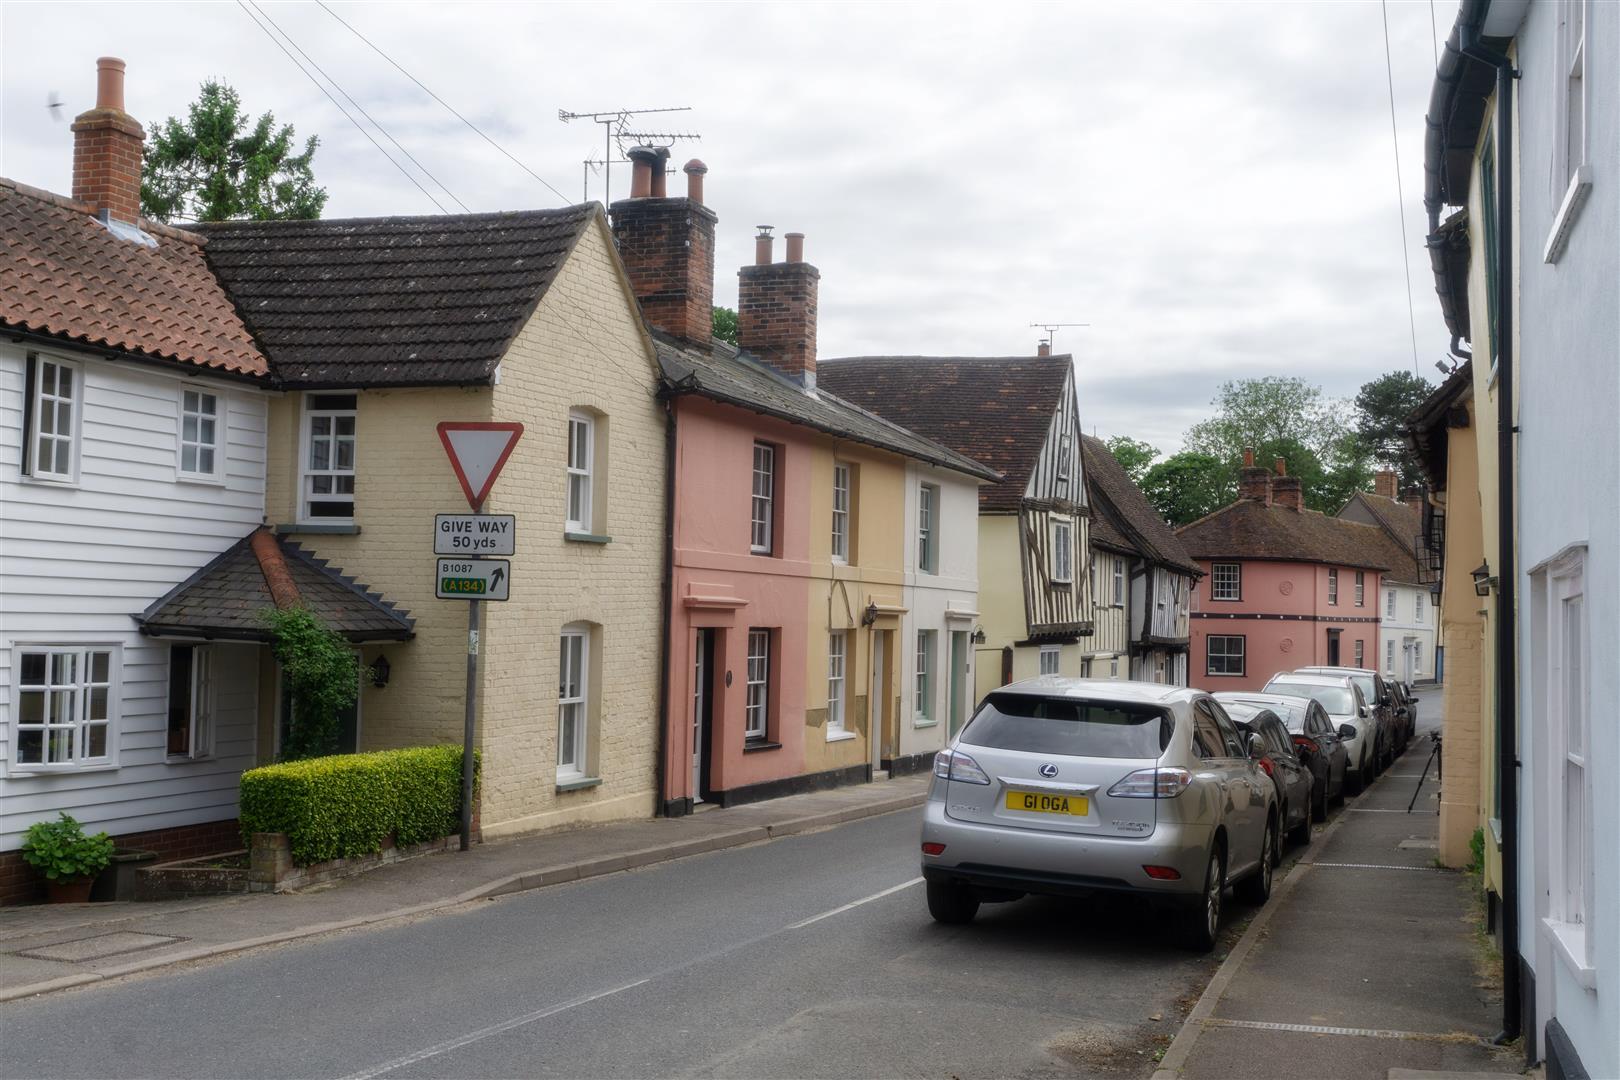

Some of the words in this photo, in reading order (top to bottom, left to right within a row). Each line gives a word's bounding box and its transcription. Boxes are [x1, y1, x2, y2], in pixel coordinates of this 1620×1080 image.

[441, 521, 472, 532] GIVE
[478, 521, 508, 533] WAY
[452, 536, 471, 548] 50
[473, 536, 496, 550] yds
[442, 564, 473, 573] B1087
[443, 579, 485, 592] (A134)
